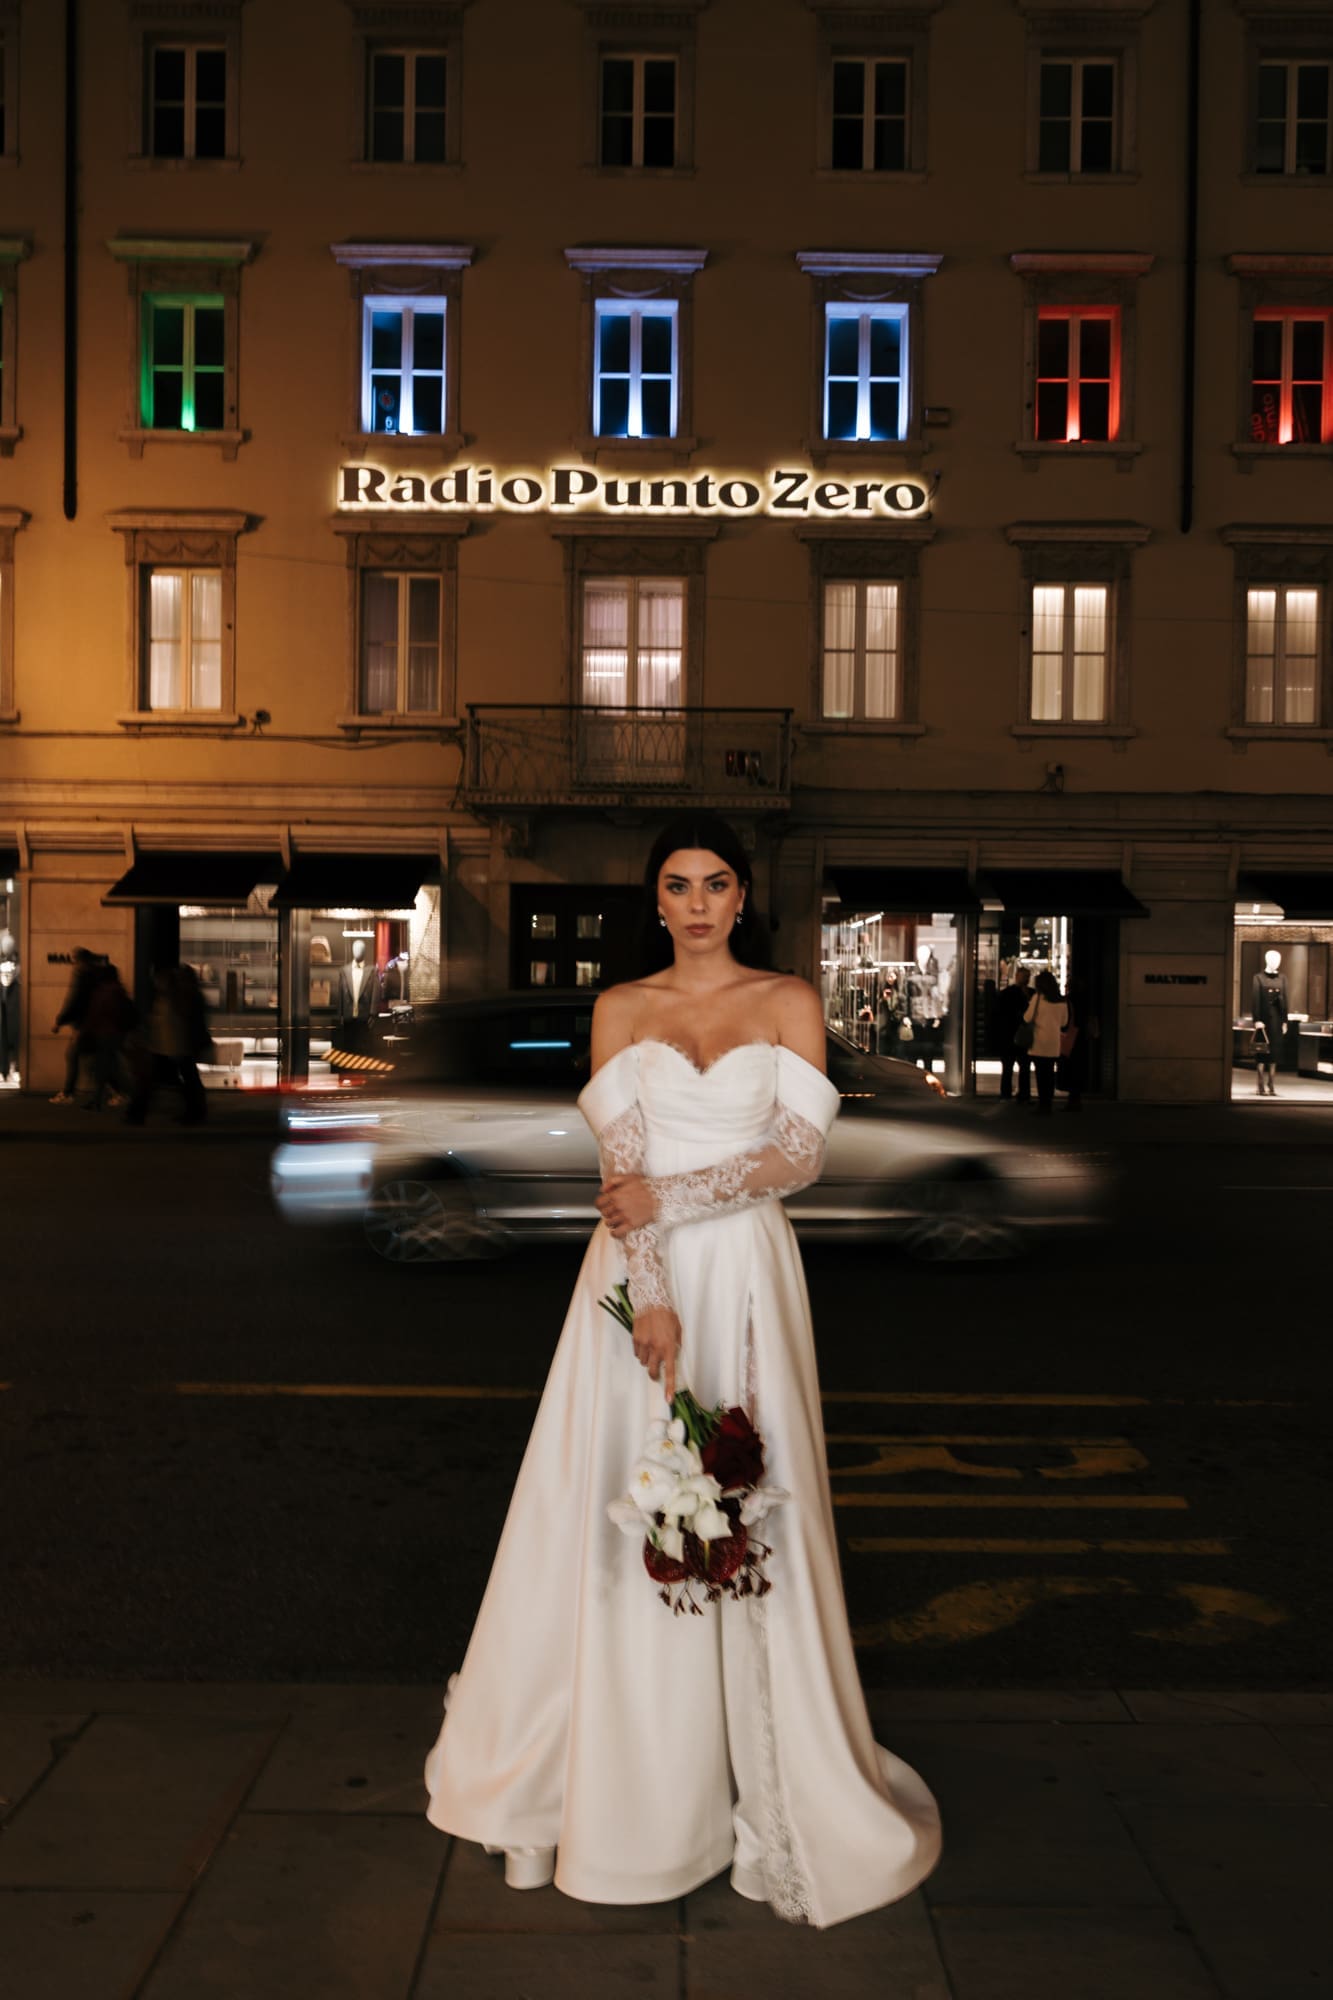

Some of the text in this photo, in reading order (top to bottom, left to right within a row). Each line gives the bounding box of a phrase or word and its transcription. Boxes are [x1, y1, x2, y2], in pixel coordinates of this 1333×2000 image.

[340, 465, 926, 511] Radio Punto Zero
